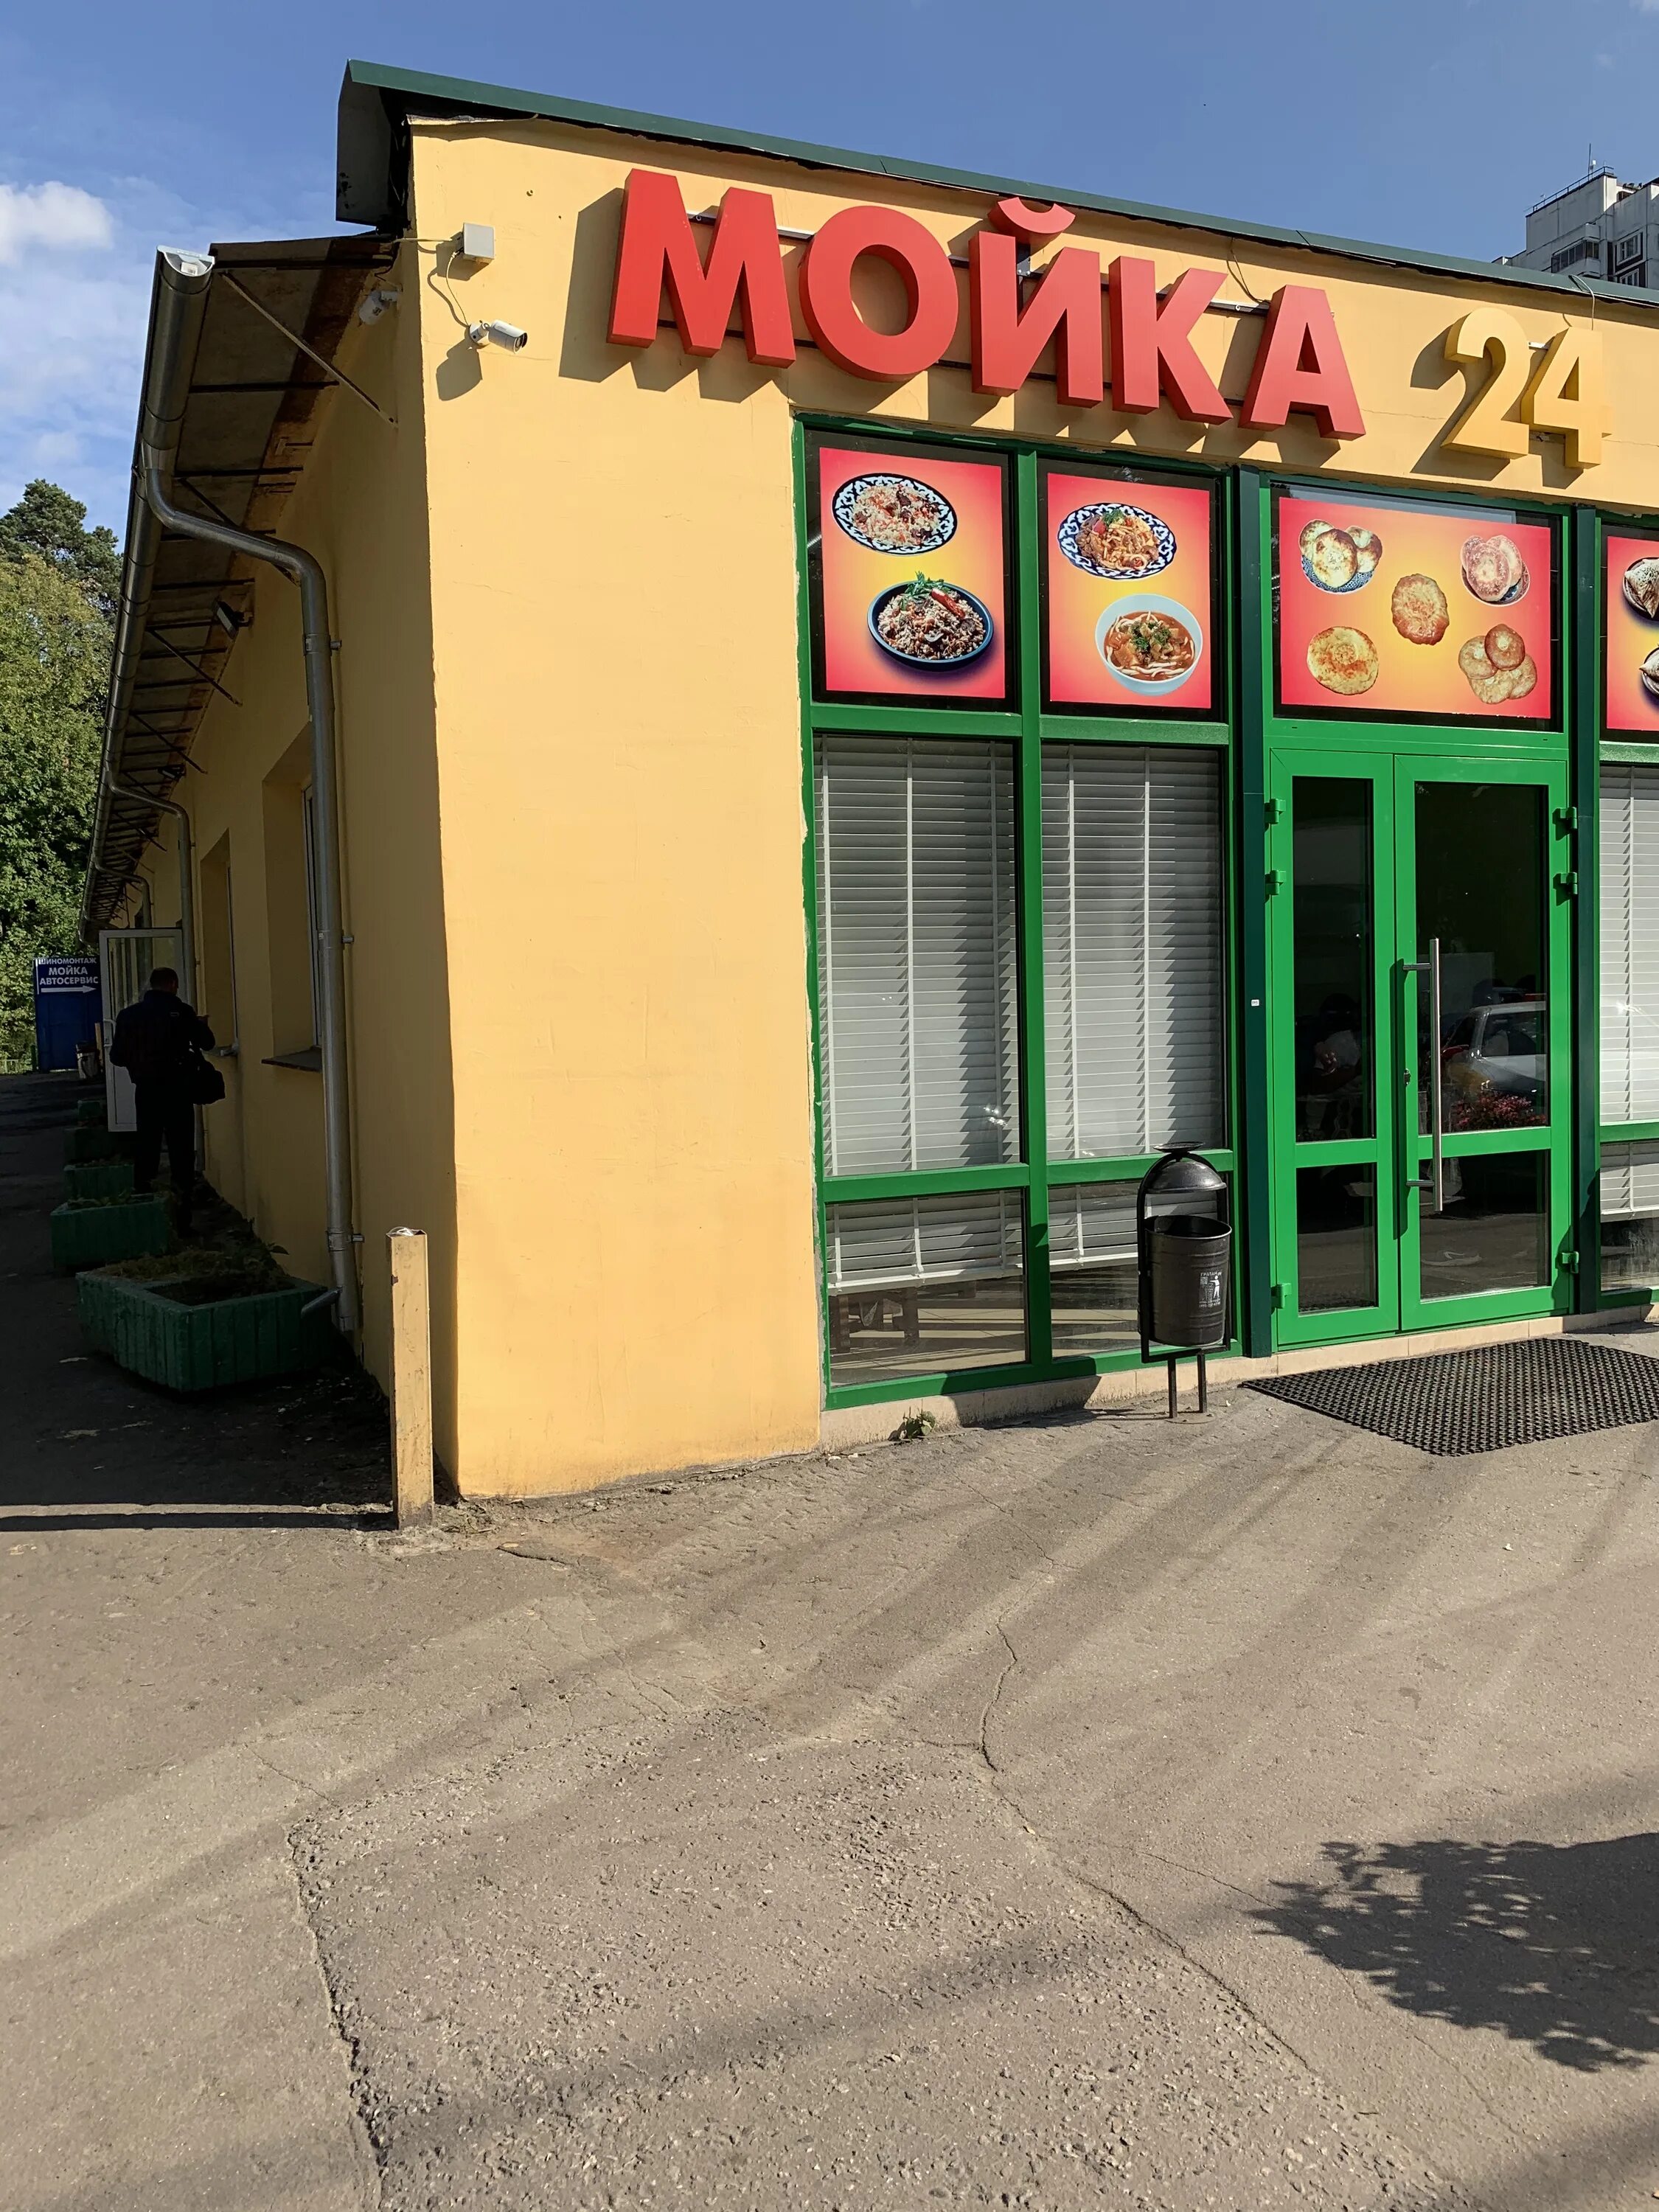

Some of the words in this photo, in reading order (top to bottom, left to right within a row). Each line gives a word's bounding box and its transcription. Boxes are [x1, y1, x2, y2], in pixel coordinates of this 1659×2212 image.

[607, 168, 1366, 440] МОЙКА
[1441, 307, 1612, 469] 24
[49, 965, 88, 975] МОЙКА
[39, 976, 99, 985] АВТОСЕРВИС
